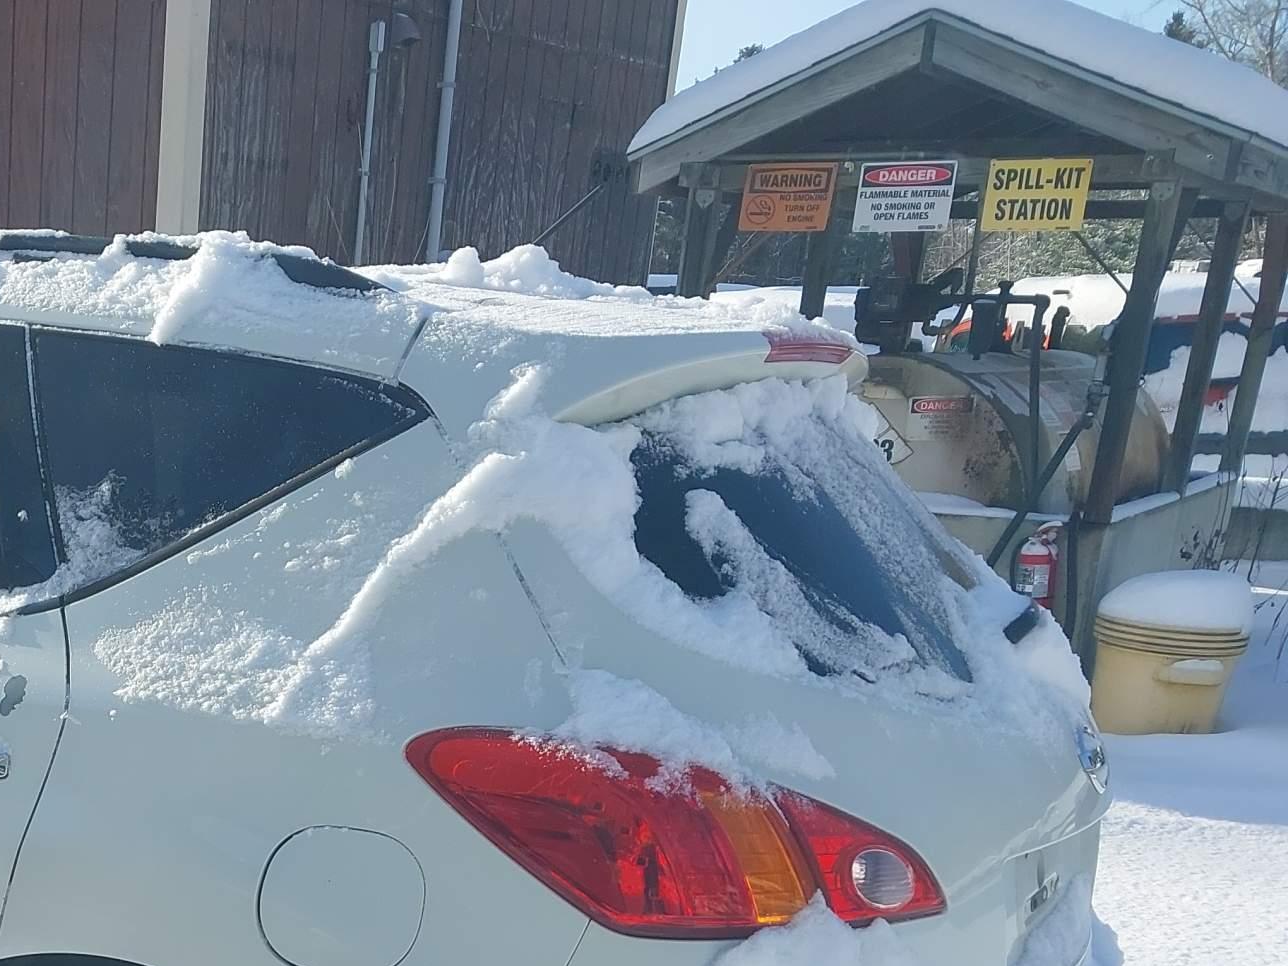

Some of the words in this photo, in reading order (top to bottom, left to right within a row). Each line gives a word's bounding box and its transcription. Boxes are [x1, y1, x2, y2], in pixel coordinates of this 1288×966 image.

[759, 173, 823, 188] WARNING
[878, 169, 937, 182] DANGER
[993, 168, 1086, 190] SPILL-KIT
[793, 193, 828, 201] SMOKING
[859, 190, 909, 199] FLAMMABLE
[910, 189, 951, 198] MATERIAL
[784, 204, 805, 212] TURN
[806, 204, 820, 212] OFF
[870, 202, 882, 211] NO
[883, 202, 922, 211] SMOKING
[923, 201, 936, 210] OR
[994, 198, 1073, 221] STATION
[786, 215, 815, 223] ENGINE
[873, 212, 896, 221] OPEN
[896, 211, 929, 221] FLAMES
